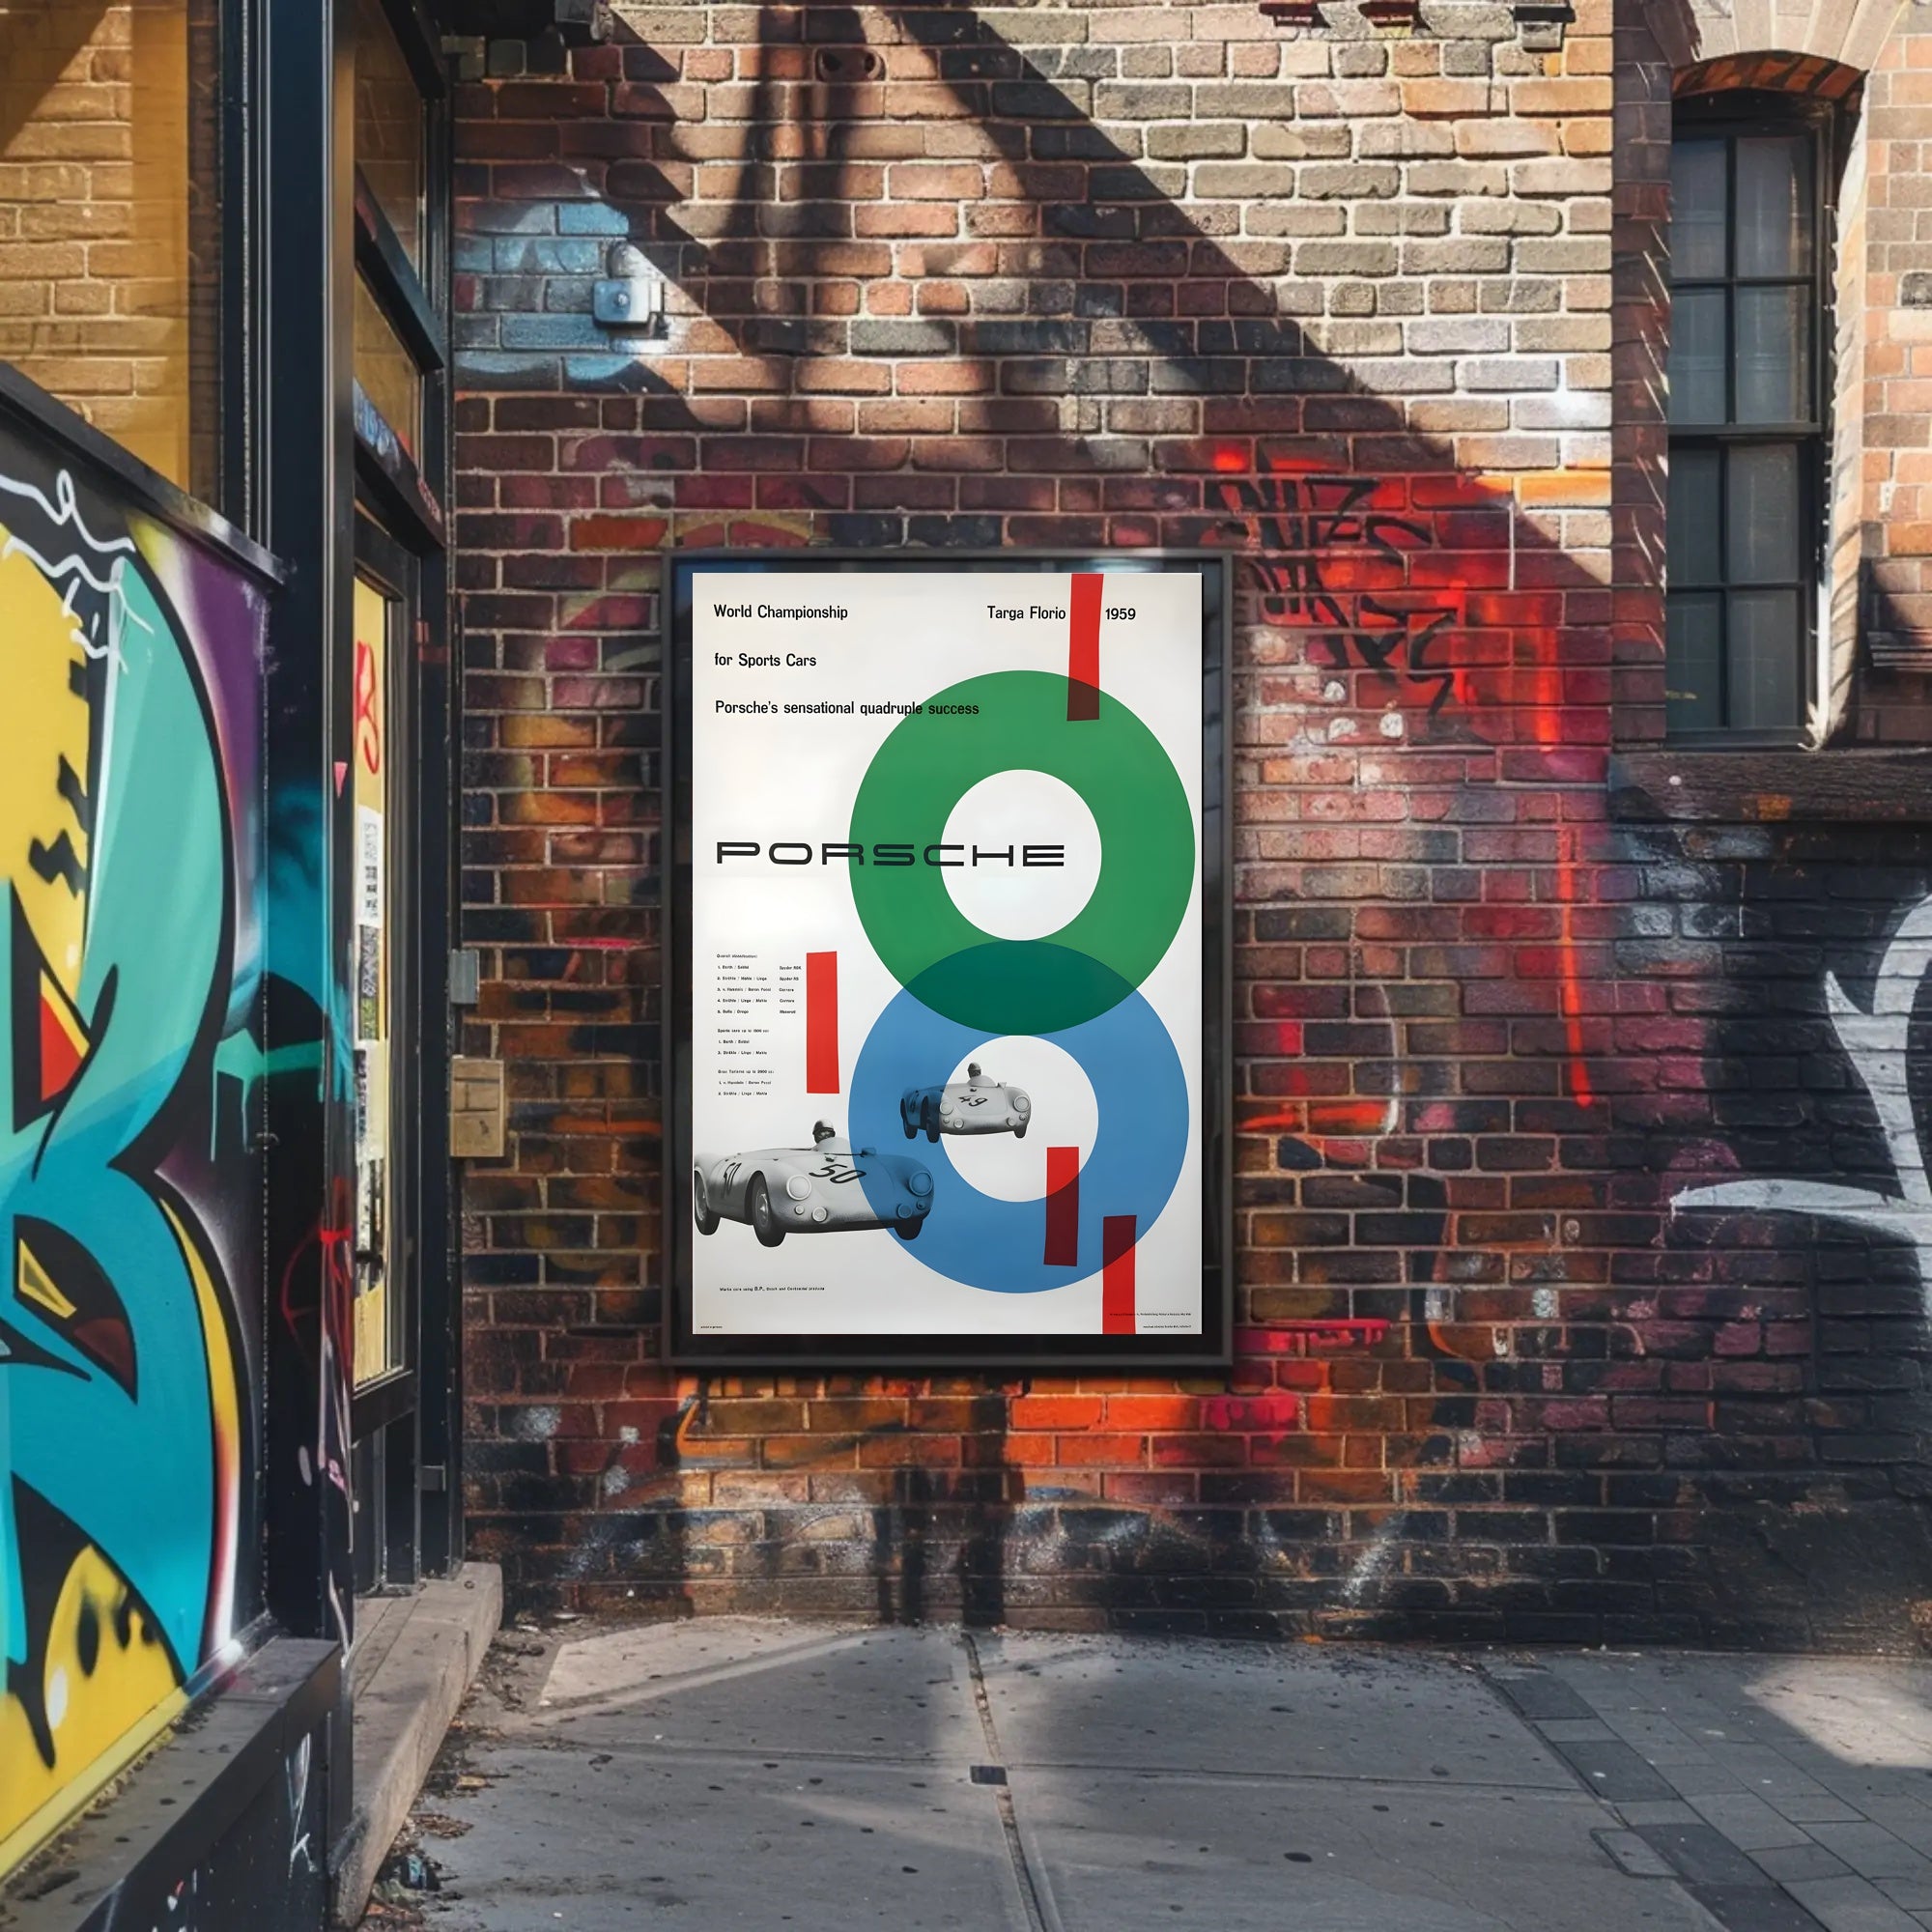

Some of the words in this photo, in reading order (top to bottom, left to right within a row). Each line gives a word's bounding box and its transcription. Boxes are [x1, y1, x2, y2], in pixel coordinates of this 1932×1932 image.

[713, 604, 753, 618] World
[757, 604, 848, 621] Championship
[986, 605, 1024, 621] Targa
[1030, 606, 1066, 620] Florio
[1105, 608, 1136, 620] 1959
[714, 652, 733, 667] for
[738, 652, 781, 668] Sports
[785, 653, 817, 668] Cars
[715, 699, 779, 714] Porsche's
[783, 700, 855, 714] sensational
[860, 700, 923, 718] quadruple
[927, 704, 980, 715] success
[717, 841, 1065, 867] PORSCHE
[957, 1095, 987, 1107] 49
[809, 1163, 867, 1184] 50
